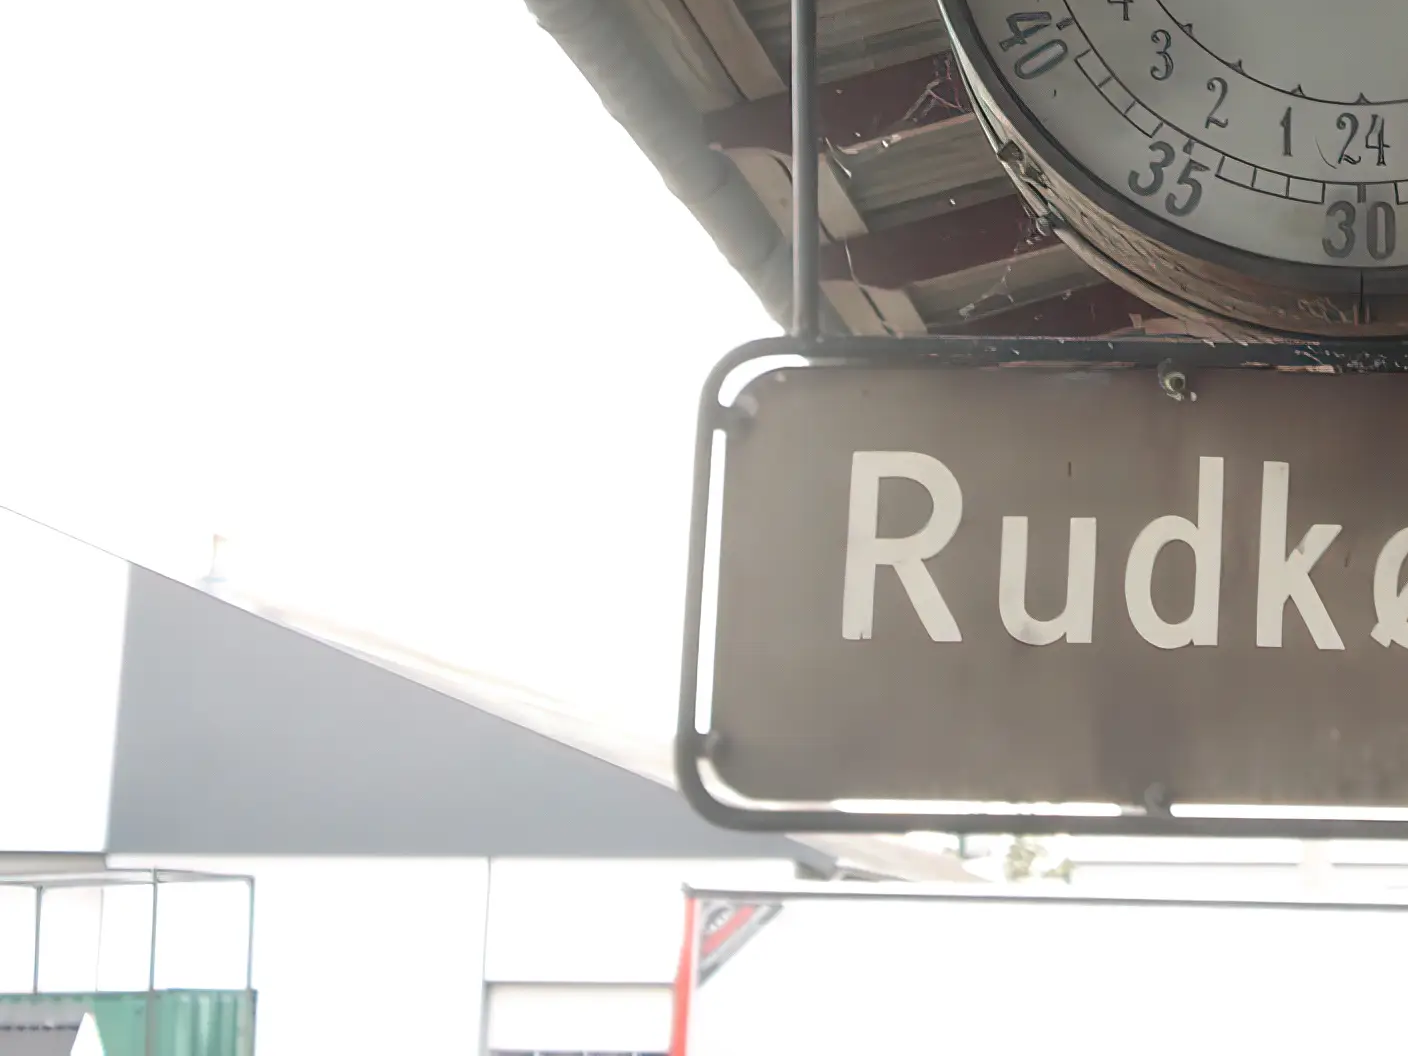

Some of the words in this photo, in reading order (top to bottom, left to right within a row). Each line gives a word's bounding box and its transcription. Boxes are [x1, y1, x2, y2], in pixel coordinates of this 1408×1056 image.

[999, 11, 1069, 80] 40
[1150, 28, 1175, 81] 3
[1205, 76, 1229, 129] 2
[1279, 106, 1293, 157] 1
[1336, 112, 1391, 166] 24
[1127, 140, 1210, 217] 35
[1321, 200, 1396, 260] 30
